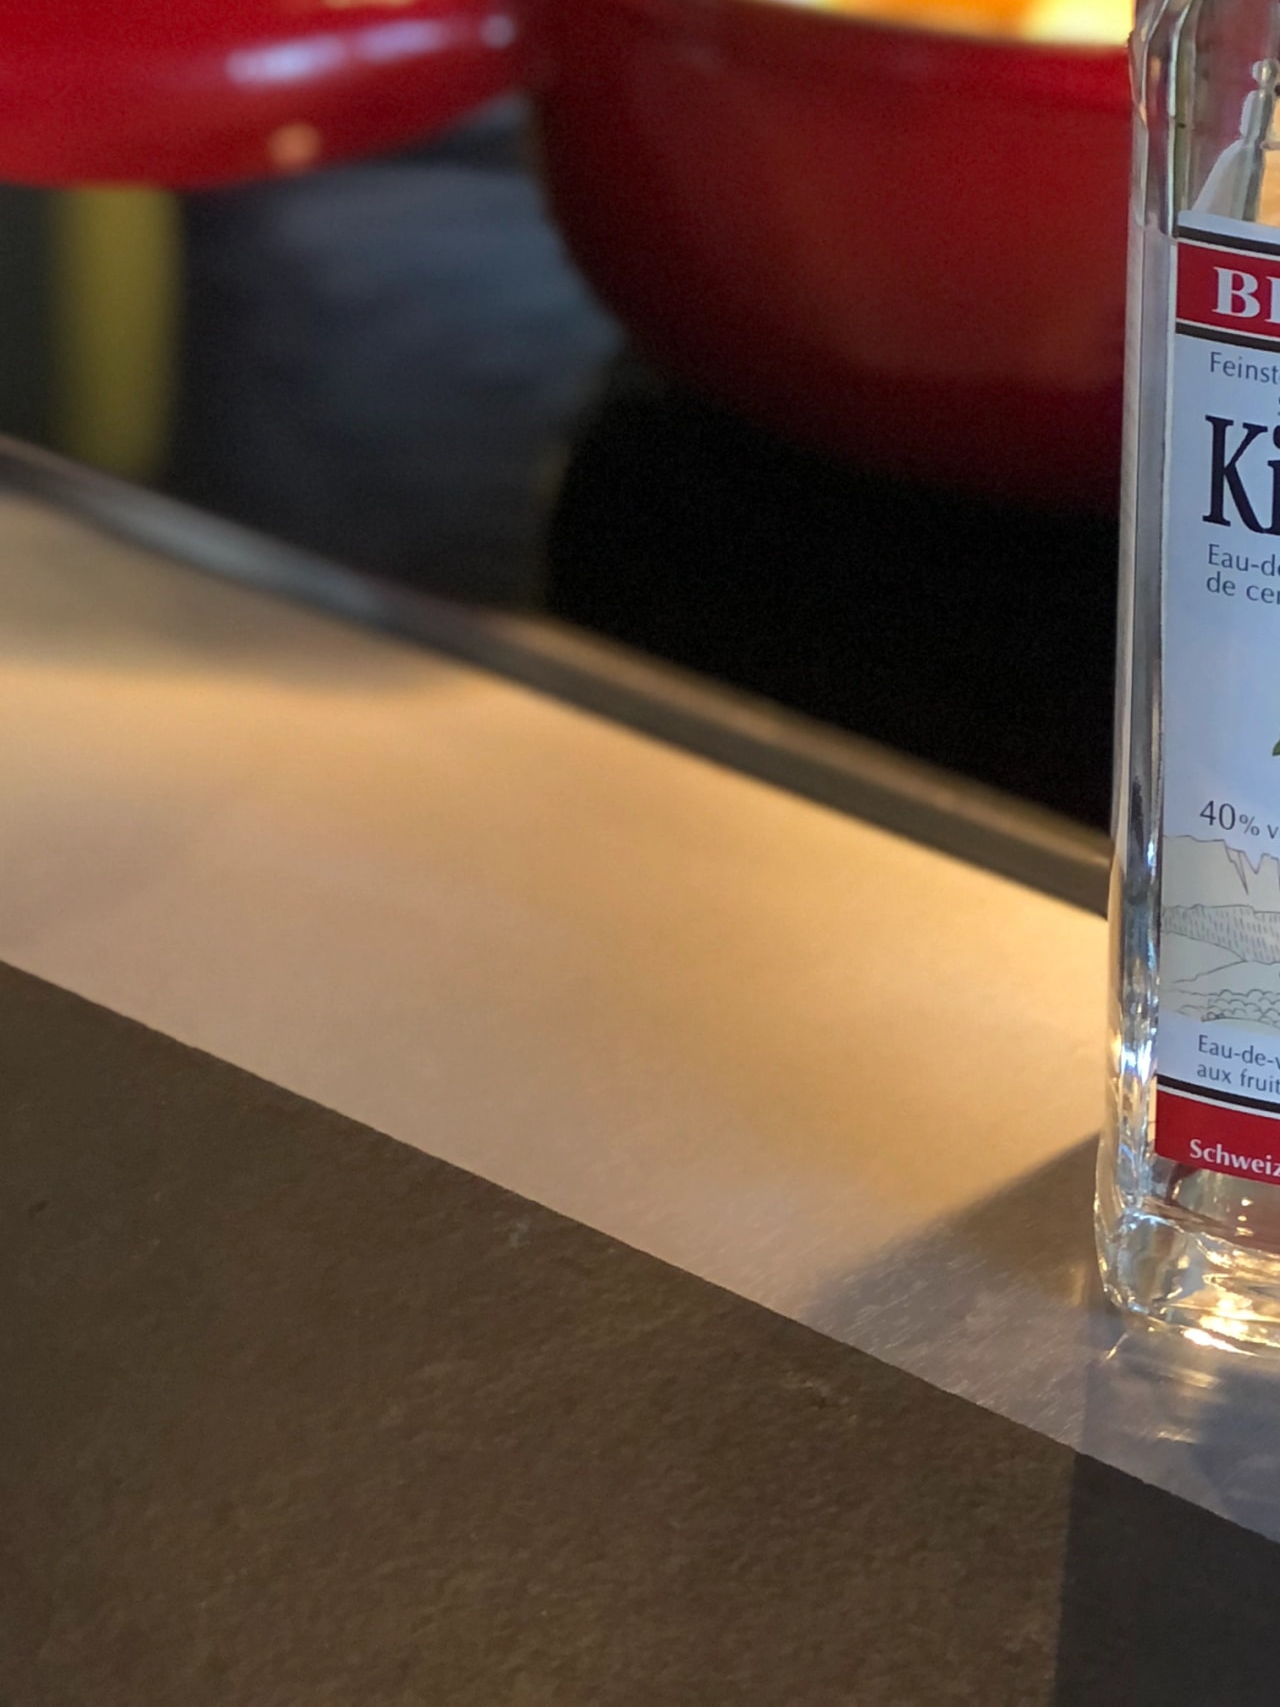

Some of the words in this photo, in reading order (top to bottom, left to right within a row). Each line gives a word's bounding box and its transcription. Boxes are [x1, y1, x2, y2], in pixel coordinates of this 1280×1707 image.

[1206, 571, 1238, 595] de
[1199, 799, 1261, 837] 40%
[1197, 1065, 1232, 1086] aux
